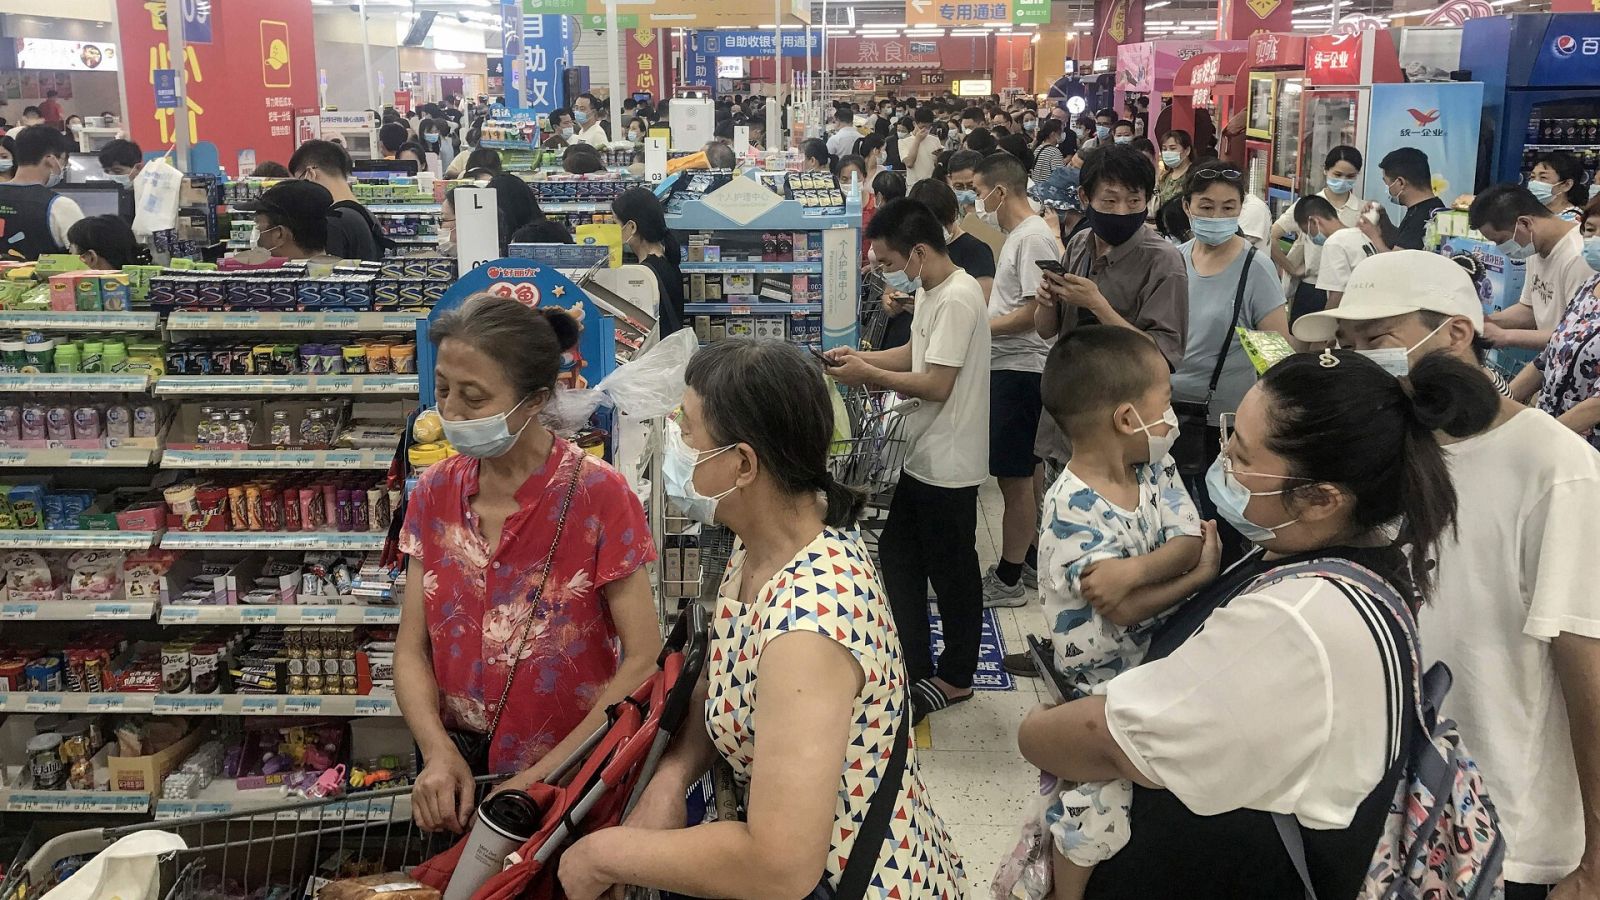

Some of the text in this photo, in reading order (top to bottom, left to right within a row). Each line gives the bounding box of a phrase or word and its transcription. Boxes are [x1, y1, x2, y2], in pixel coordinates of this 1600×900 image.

[940, 3, 1007, 20] 专用通道
[858, 41, 903, 62] 熟食
[1400, 128, 1443, 137] 统一企业
[654, 140, 658, 149] L
[651, 173, 661, 181] 03
[474, 194, 482, 209] L
[838, 239, 848, 301] 个人护理中心
[15, 557, 35, 566] Dove
[84, 551, 113, 562] Dove
[133, 570, 151, 578] Dove
[161, 655, 185, 665] Dove
[191, 656, 214, 667] Dove
